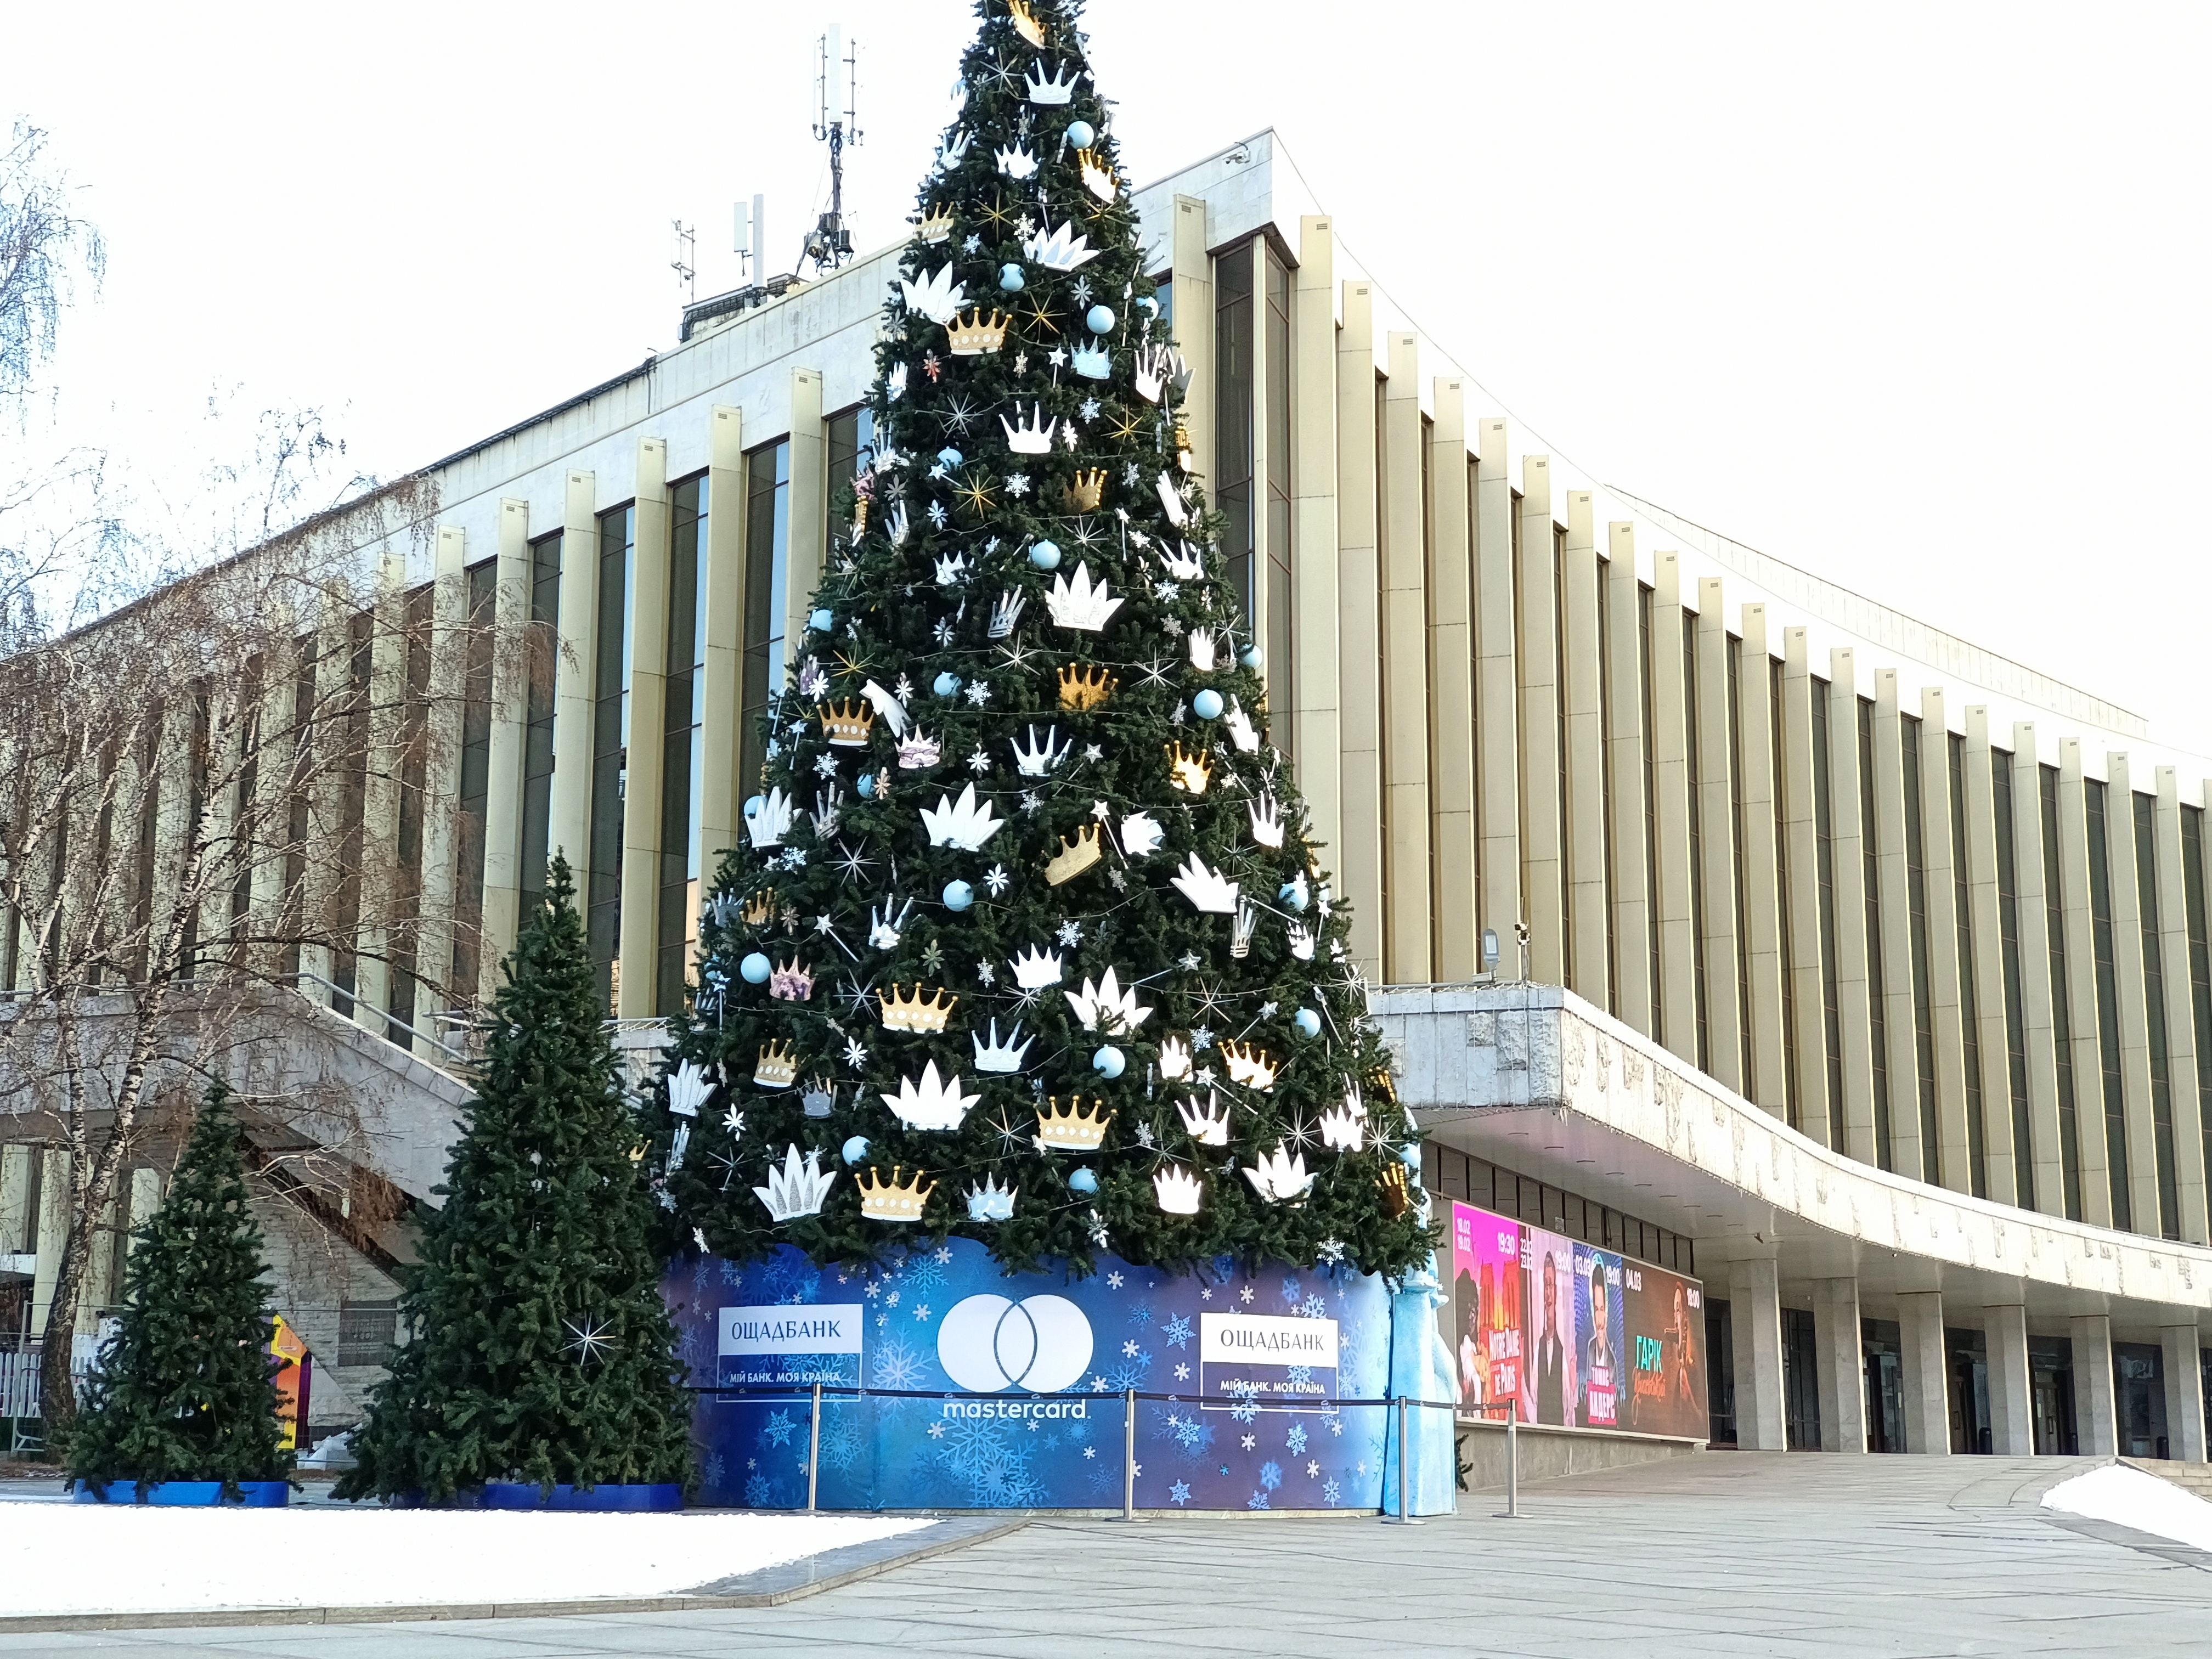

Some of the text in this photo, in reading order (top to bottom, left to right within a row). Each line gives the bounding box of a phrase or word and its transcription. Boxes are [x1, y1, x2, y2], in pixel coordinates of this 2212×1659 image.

[1497, 1232, 1515, 1255] 19:30
[1555, 1250, 1571, 1273] 19:00
[1575, 1255, 1591, 1276] 03.03
[1606, 1265, 1620, 1286] 19:00
[1626, 1268, 1642, 1291] 04.03
[732, 1320, 841, 1342] ОЩАДБАНК
[1221, 1329, 1324, 1352] ОЩАДБАНК
[1635, 1335, 1662, 1373] ГАРІК
[730, 1370, 840, 1383] МІЙ БАНК. МОЯ КРАЇНА
[1220, 1378, 1325, 1394] МІЙ БАНК. МОЯ КРАЇНА
